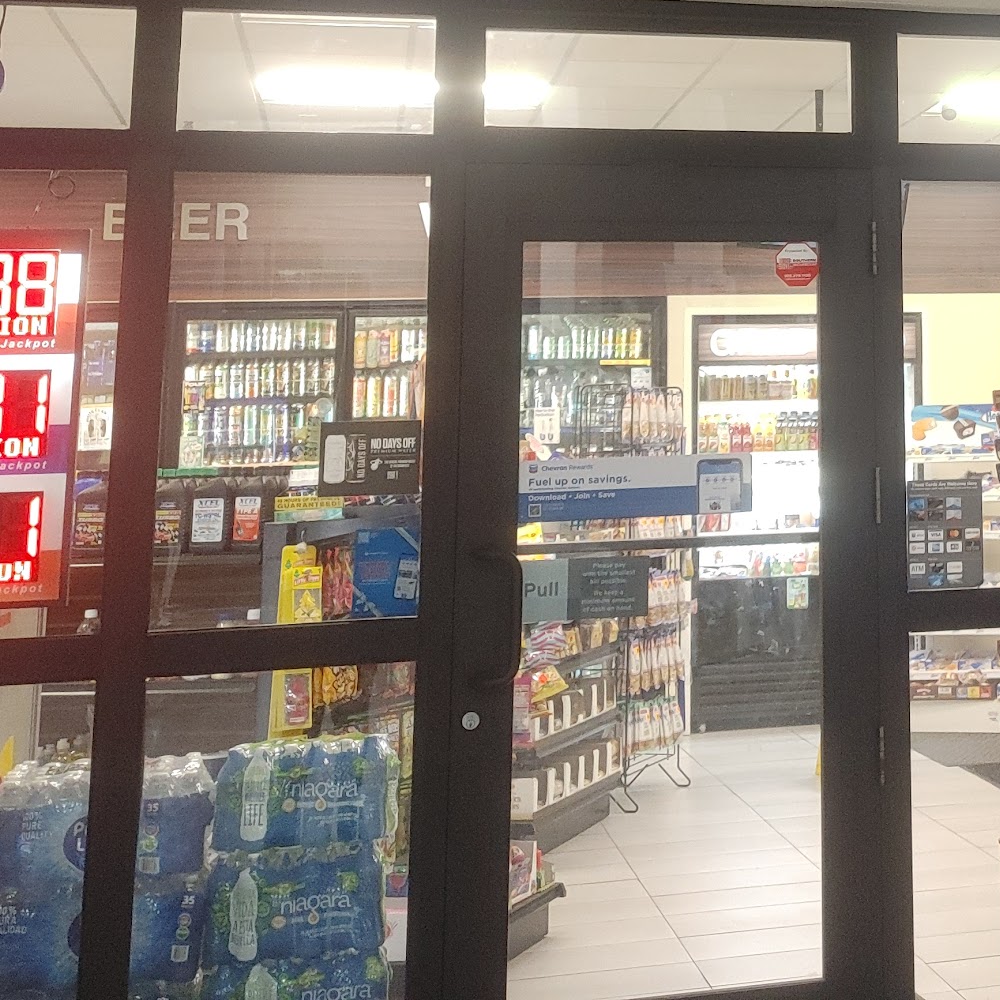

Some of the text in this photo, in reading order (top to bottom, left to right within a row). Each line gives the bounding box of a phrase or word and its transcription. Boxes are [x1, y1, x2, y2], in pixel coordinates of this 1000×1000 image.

[0, 338, 56, 351] Jackpot
[370, 437, 416, 450] NO DAYS OFF
[528, 474, 631, 487] Fuel up on savings.
[528, 491, 616, 501] Download Join Save
[911, 565, 925, 573] ATM
[0, 583, 43, 595] ckpot
[524, 581, 559, 597] Pull
[291, 780, 358, 811] niagara
[147, 802, 160, 812] 35
[181, 895, 195, 905] 35
[280, 893, 351, 925] niagara
